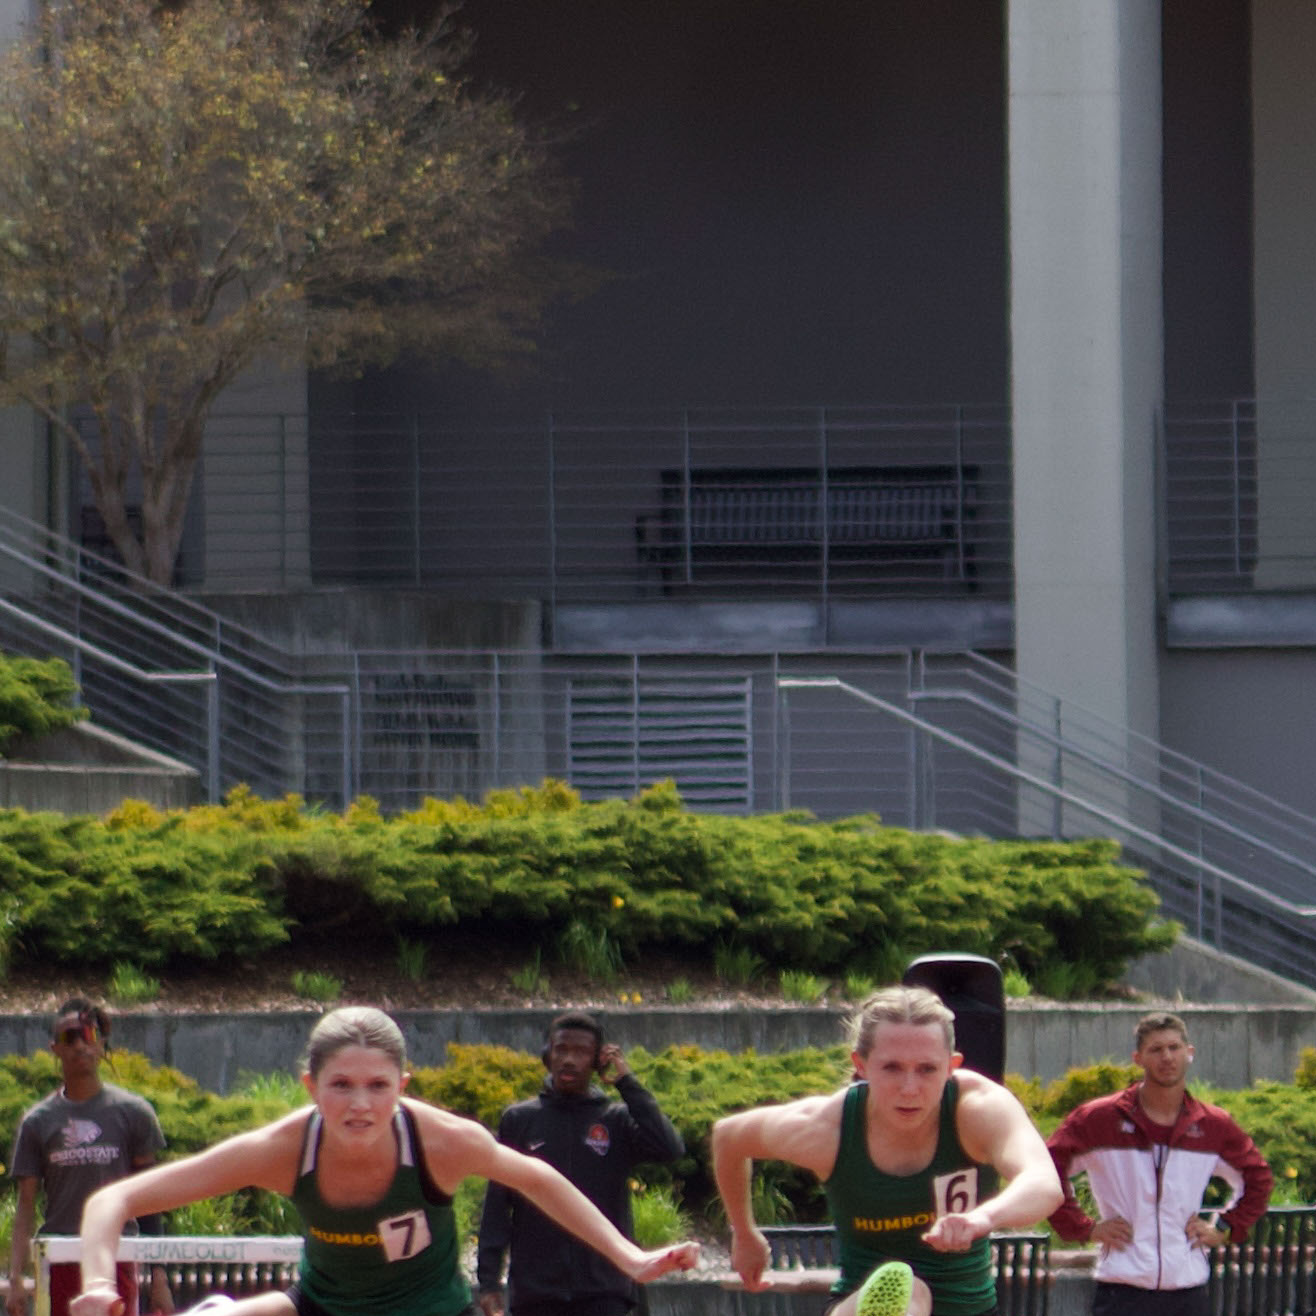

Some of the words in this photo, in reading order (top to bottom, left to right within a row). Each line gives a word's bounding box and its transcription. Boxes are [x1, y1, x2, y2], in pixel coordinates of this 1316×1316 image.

[946, 1174, 969, 1213] 6
[309, 1226, 385, 1246] HUMBO
[389, 1207, 415, 1257] 7
[854, 1212, 936, 1232] HUMBO
